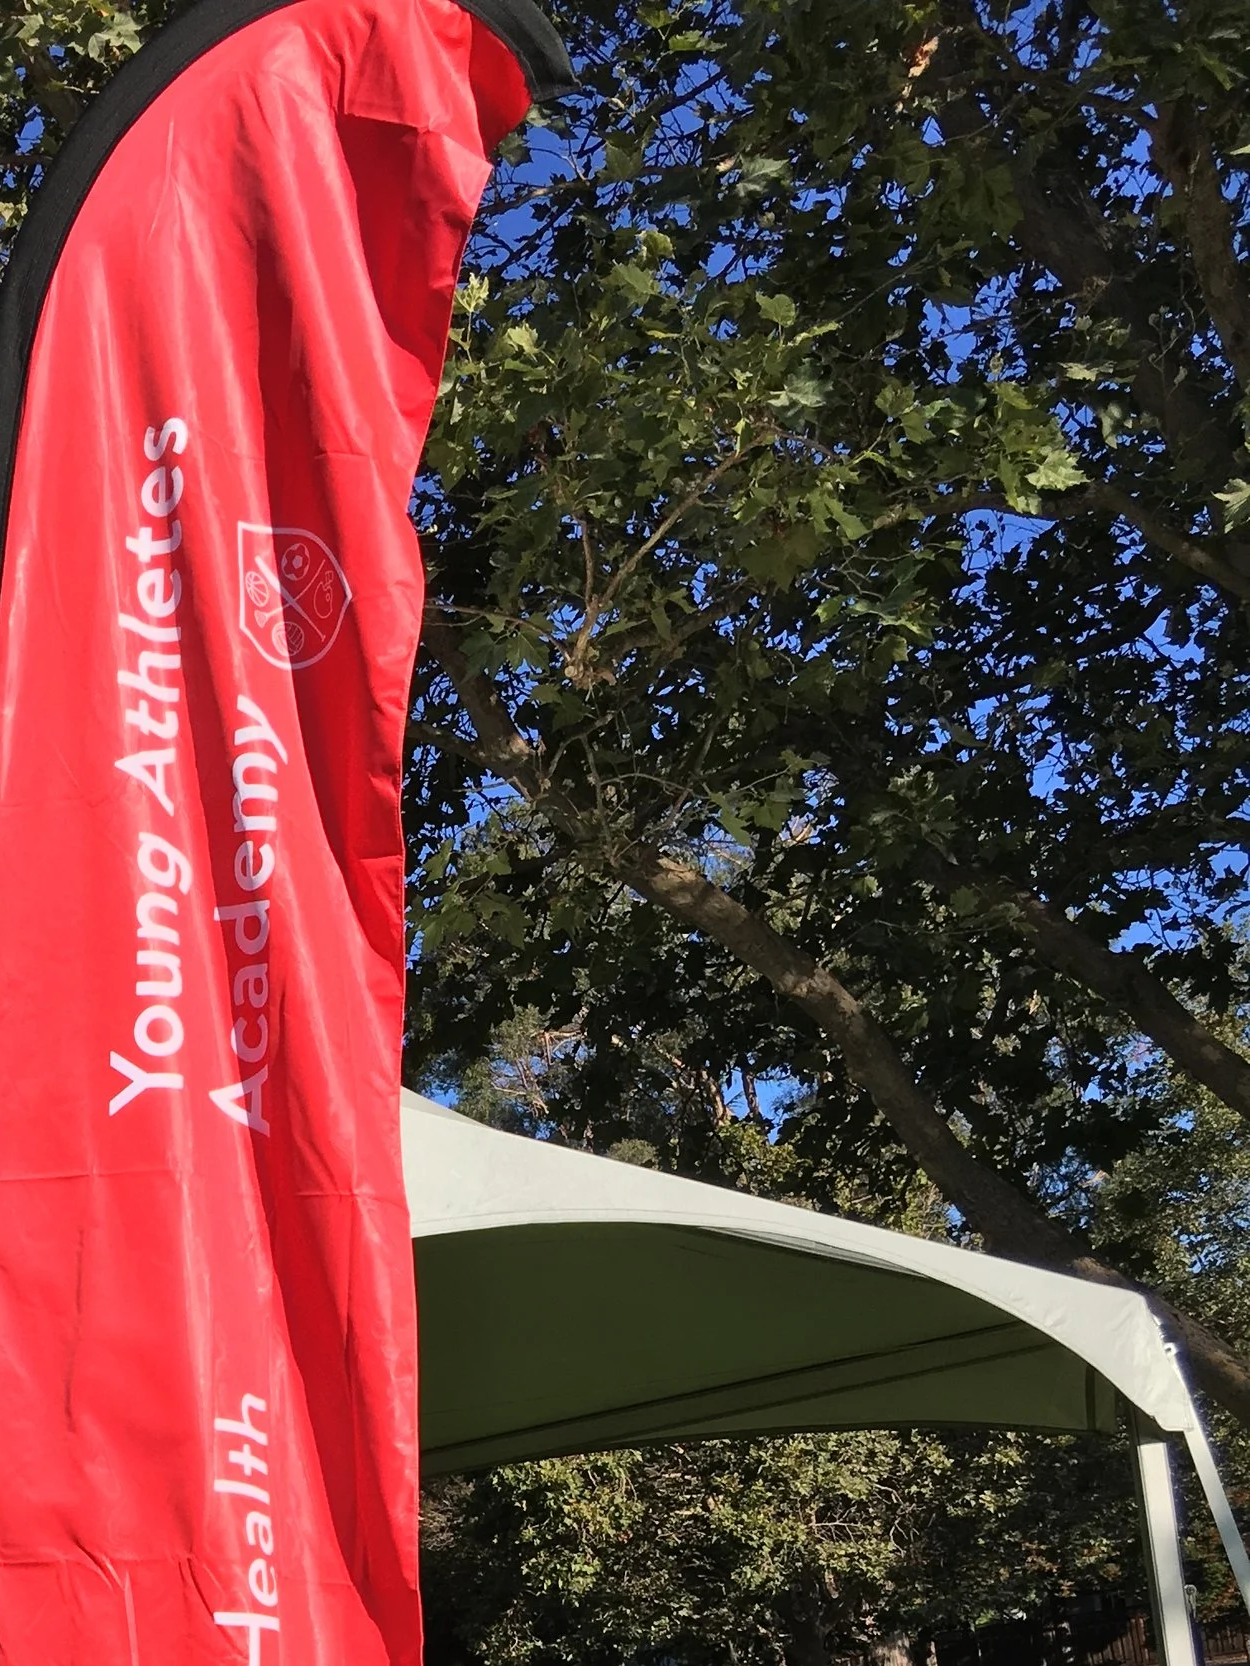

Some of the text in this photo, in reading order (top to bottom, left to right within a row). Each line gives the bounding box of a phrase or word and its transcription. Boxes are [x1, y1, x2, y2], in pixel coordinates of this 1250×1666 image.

[108, 416, 192, 1116] Young Athletes
[209, 695, 289, 1136] Academy
